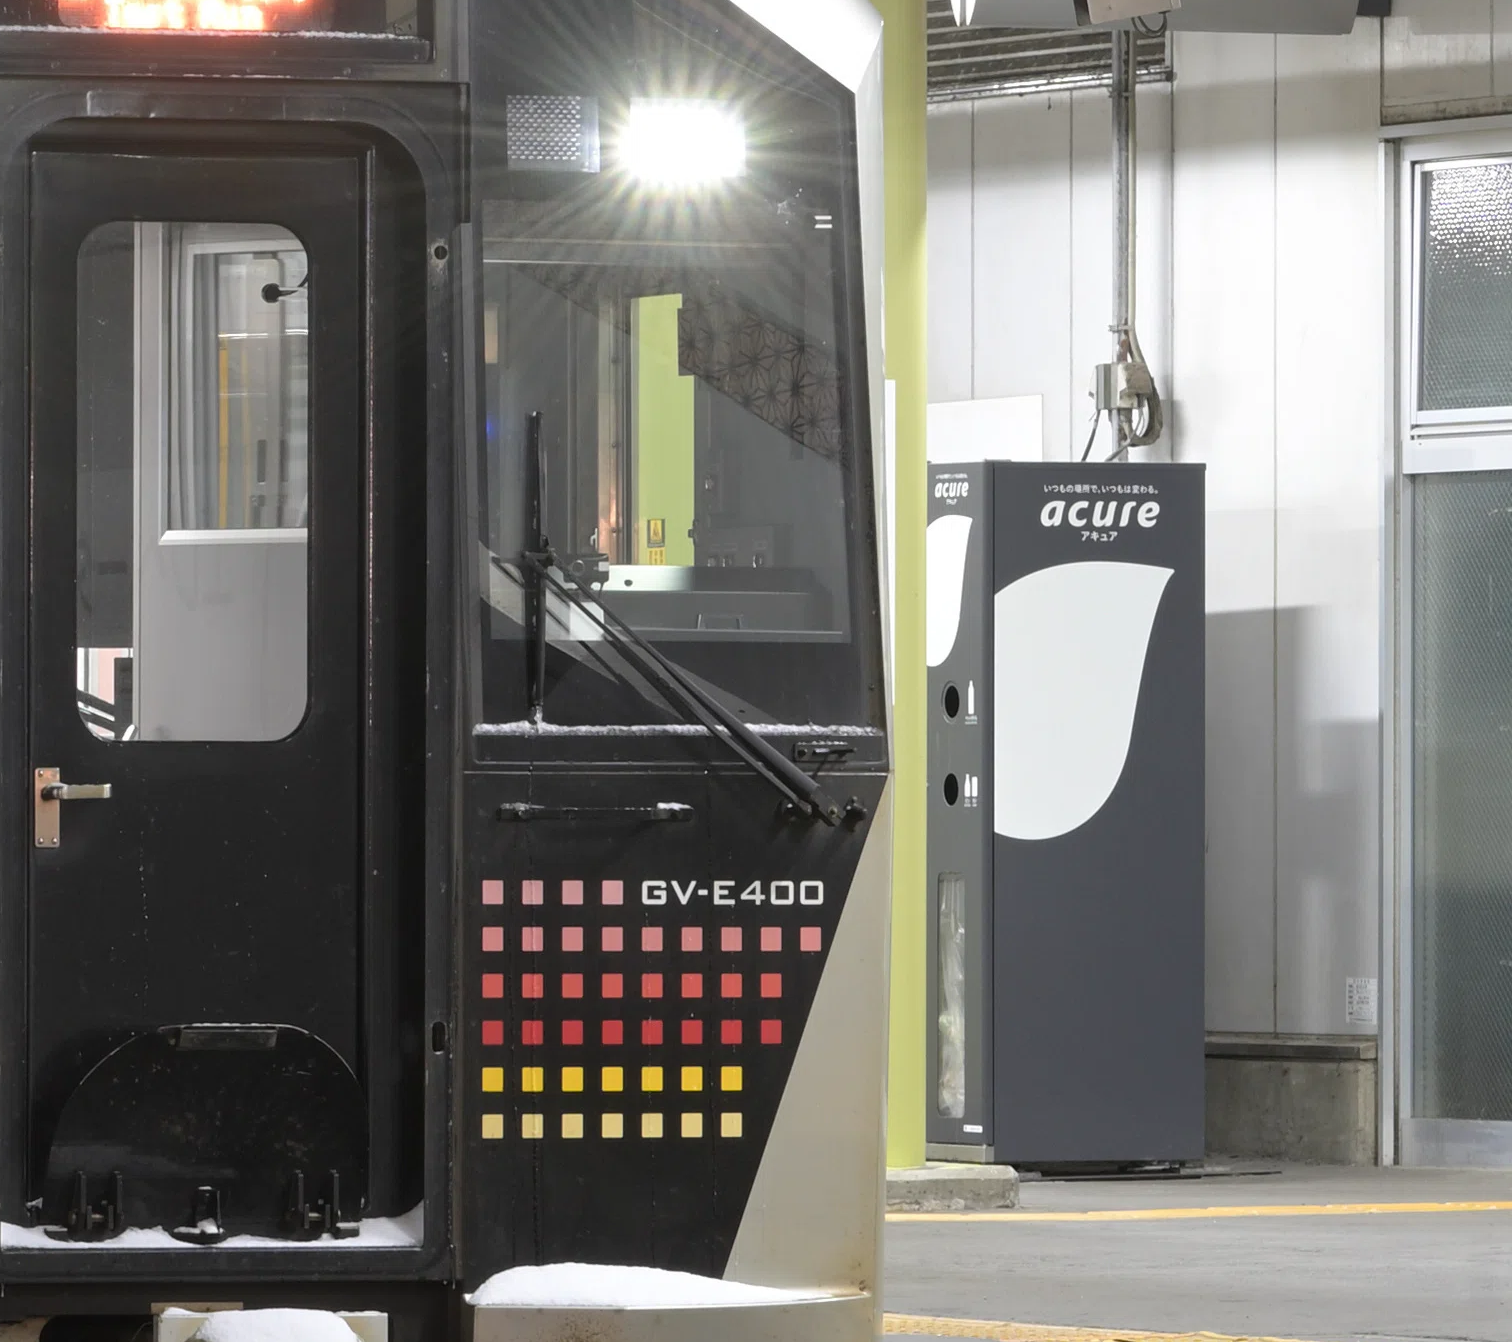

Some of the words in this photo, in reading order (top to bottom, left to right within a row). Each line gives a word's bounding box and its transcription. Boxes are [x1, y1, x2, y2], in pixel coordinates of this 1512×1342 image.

[934, 481, 969, 498] acure
[1039, 499, 1161, 528] acure
[1080, 531, 1118, 541] アキュア
[641, 879, 825, 906] GV-E400
